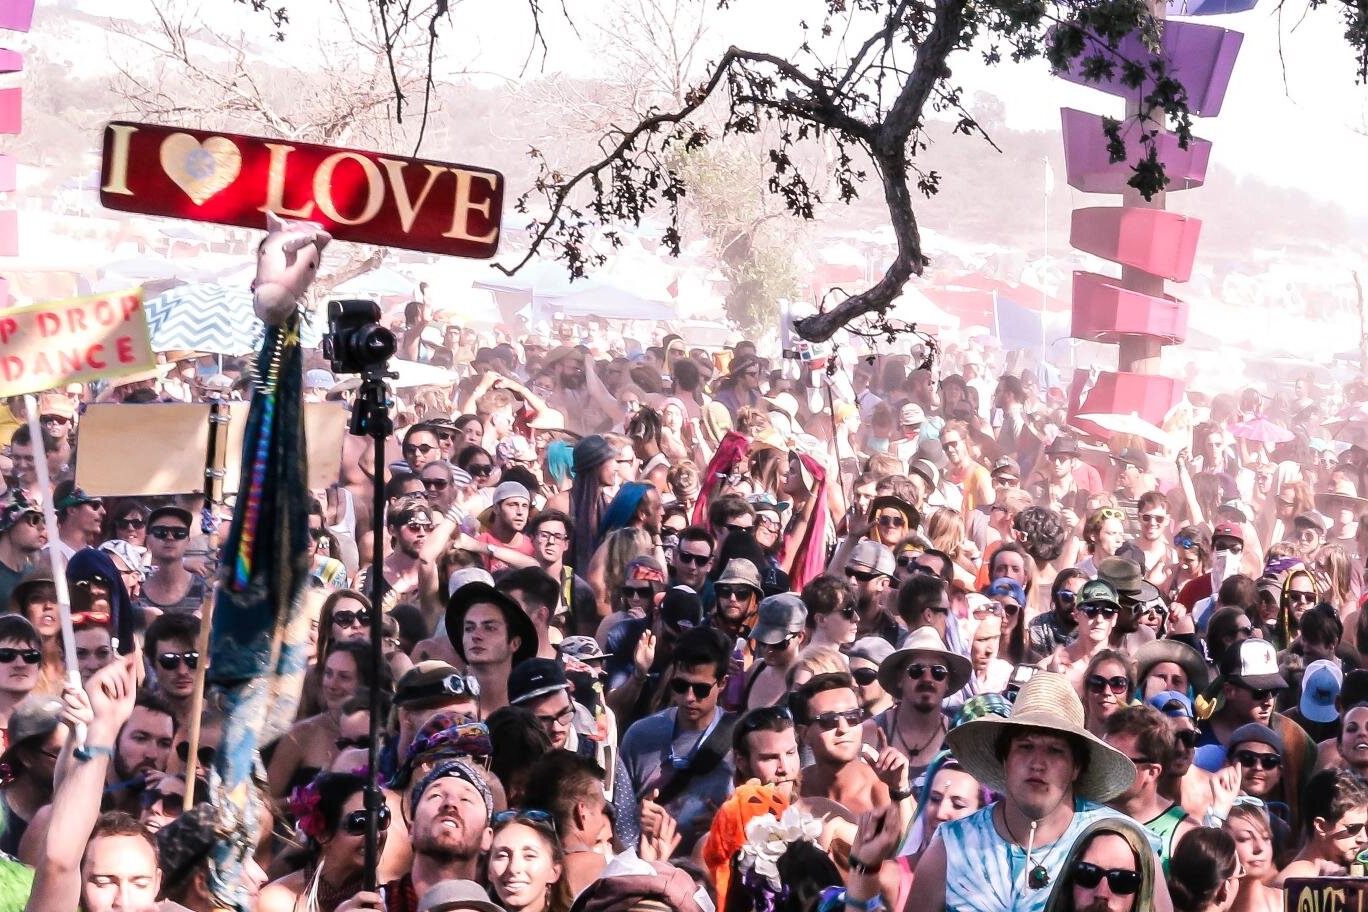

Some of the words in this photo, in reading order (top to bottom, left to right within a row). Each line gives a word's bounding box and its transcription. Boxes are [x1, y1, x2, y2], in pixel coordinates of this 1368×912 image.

[102, 125, 138, 196] I
[257, 143, 499, 243] LOVE
[35, 295, 140, 338] DROP
[0, 336, 136, 382] DANCE
